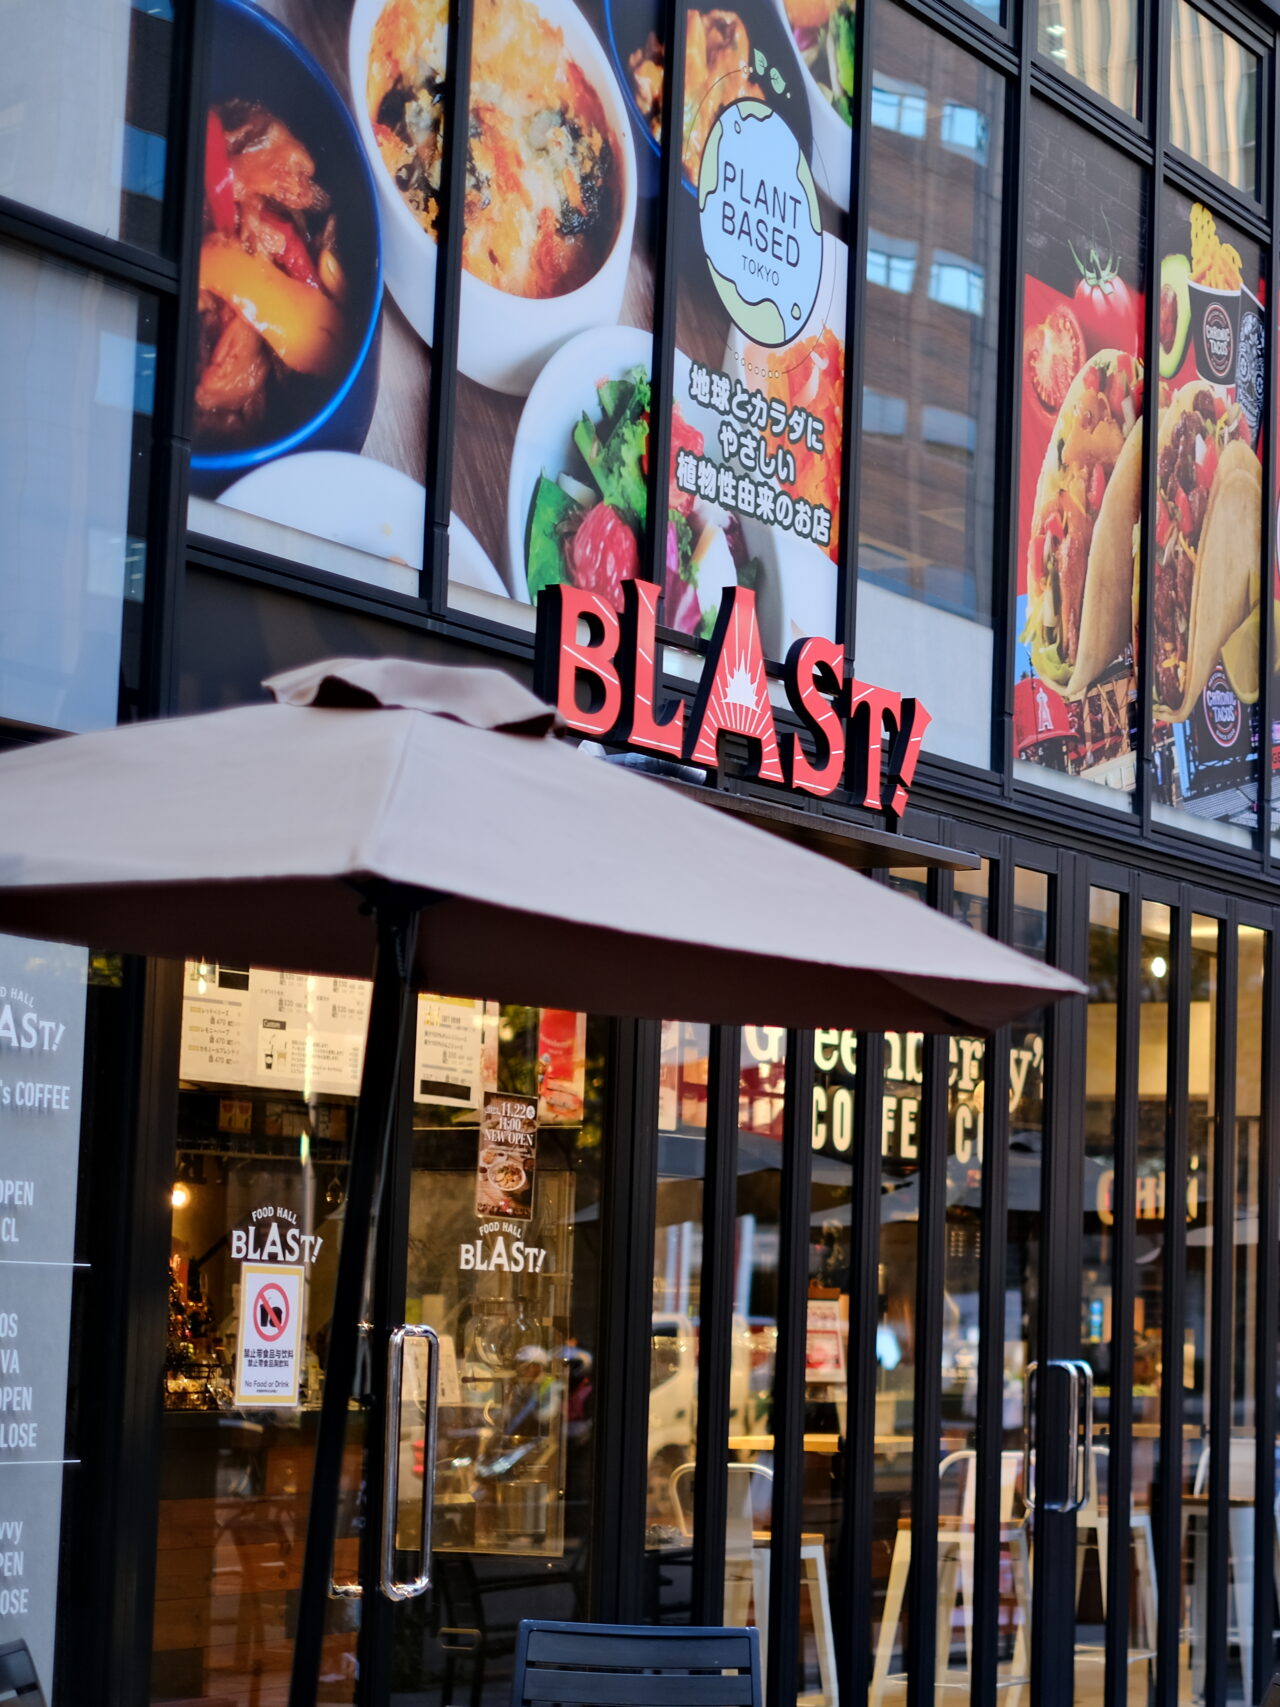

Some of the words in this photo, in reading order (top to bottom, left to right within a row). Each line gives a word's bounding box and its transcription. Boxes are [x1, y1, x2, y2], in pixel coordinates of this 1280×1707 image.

[723, 160, 802, 230] PLANT
[721, 200, 801, 268] BASED
[741, 254, 780, 287] TOKYO
[690, 363, 824, 452] 地球とカラダに
[719, 424, 795, 483] やさしい
[676, 450, 831, 544] 植物性由来のお店
[556, 578, 933, 818] BLAST!
[1211, 704, 1236, 723] TACOS
[11, 986, 35, 1008] HALL
[15, 1081, 71, 1110] COFFEE
[484, 1128, 505, 1143] NEW
[508, 1131, 533, 1146] OPEN
[252, 1206, 275, 1223] FOOD
[277, 1206, 297, 1224] HALL
[479, 1222, 500, 1237] FOOD
[502, 1222, 522, 1239] HALL
[231, 1222, 323, 1263] BLAST!
[460, 1236, 547, 1273] BLAST!
[245, 1380, 252, 1388] No
[253, 1380, 268, 1388] Food
[275, 1380, 289, 1388] Drink
